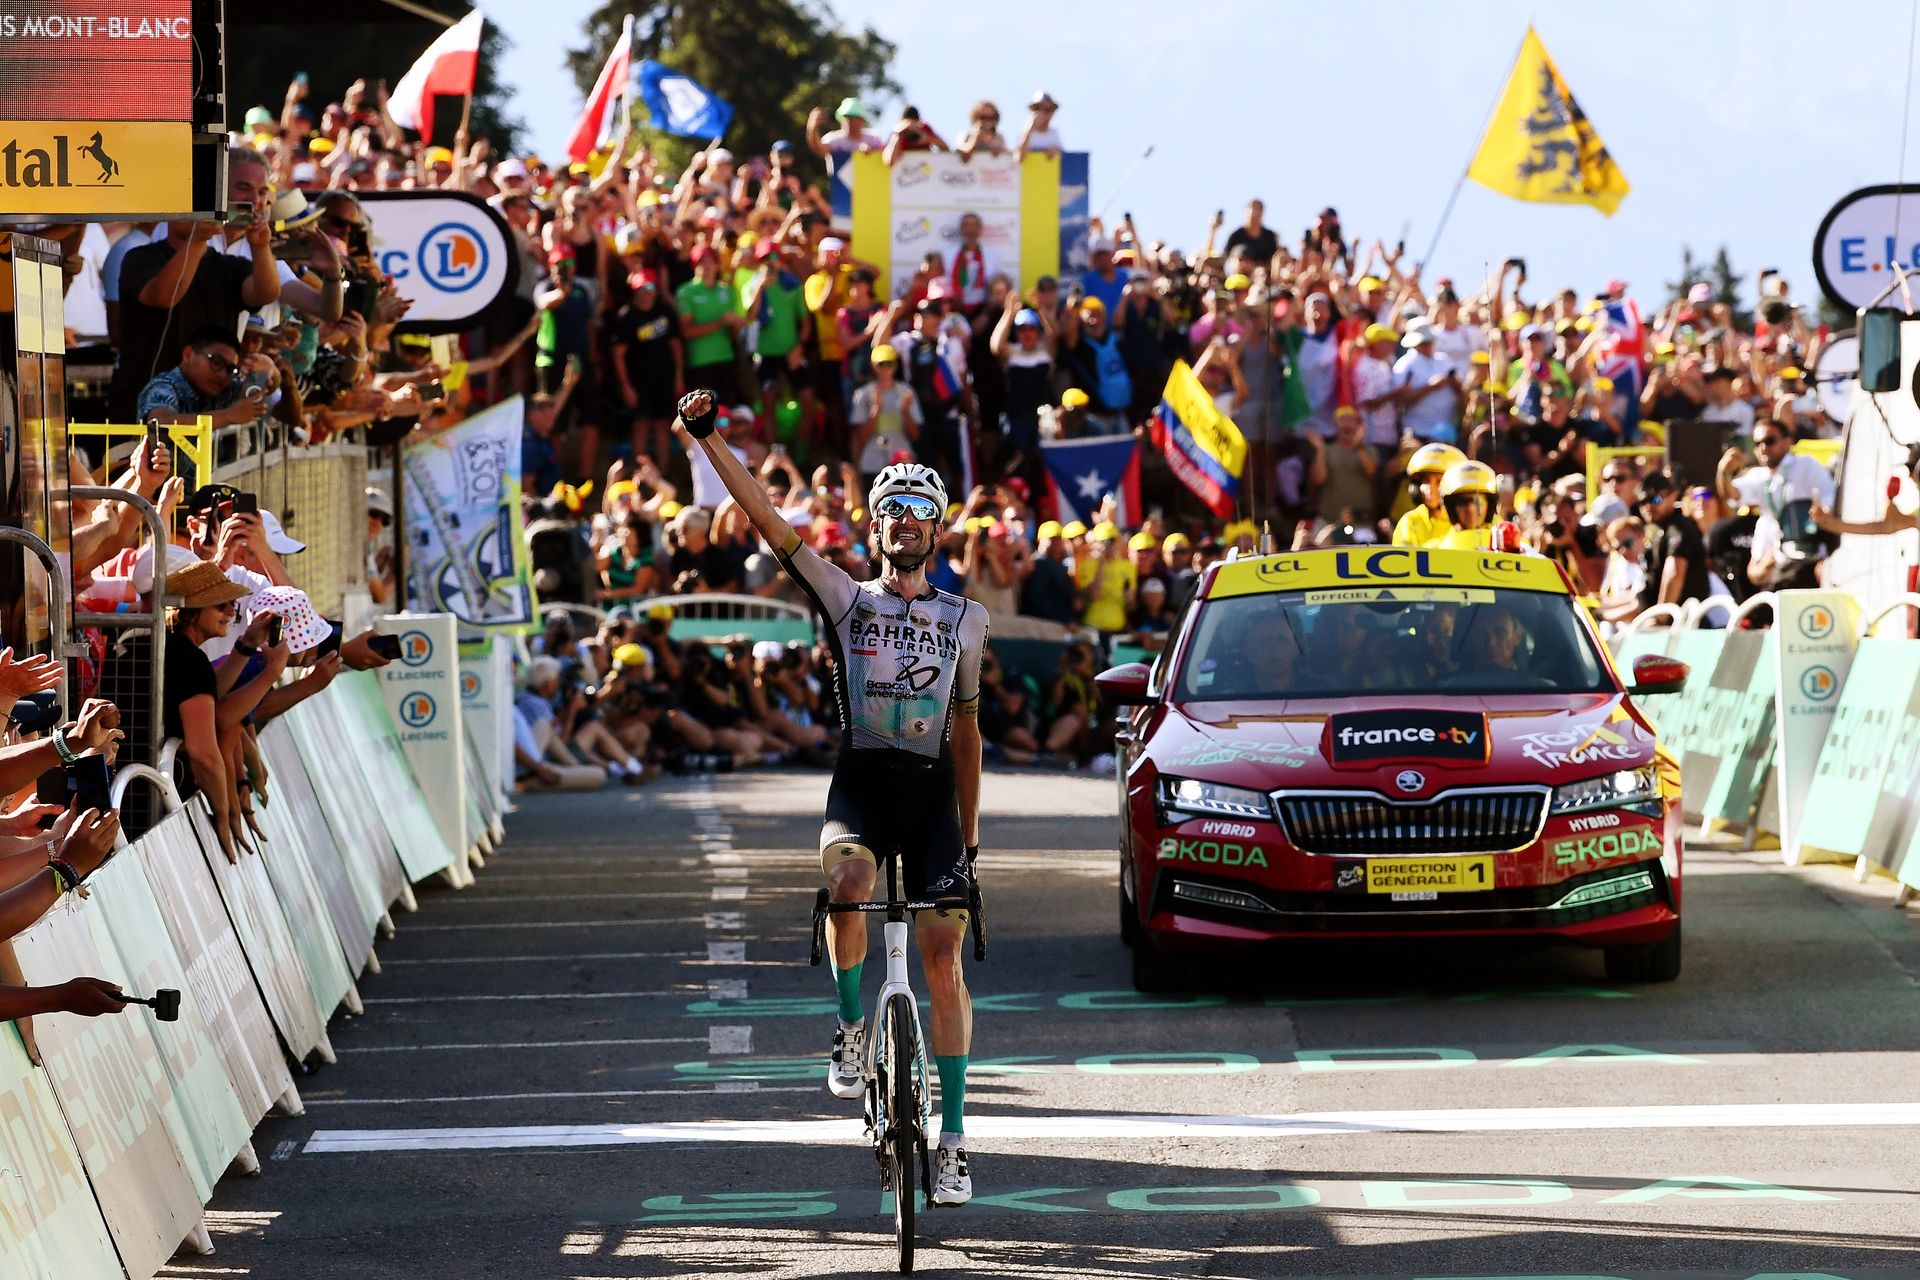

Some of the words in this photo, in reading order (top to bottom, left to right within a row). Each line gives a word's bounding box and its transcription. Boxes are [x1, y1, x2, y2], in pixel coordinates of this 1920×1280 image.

[22, 15, 190, 39] MONT-BLANC
[0, 134, 73, 188] tal
[1261, 559, 1309, 574] LCL
[1335, 551, 1454, 579] LCL
[1482, 557, 1531, 574] LCL
[1311, 591, 1371, 602] OFFICIEL
[850, 618, 957, 652] BAHRAIN
[850, 634, 957, 661] VICTORIOUS
[865, 690, 919, 701] energies
[1202, 820, 1257, 838] HYBRID
[1568, 813, 1621, 832] HYBRID
[1372, 862, 1457, 875] DIRECTION
[1468, 862, 1485, 884] 1
